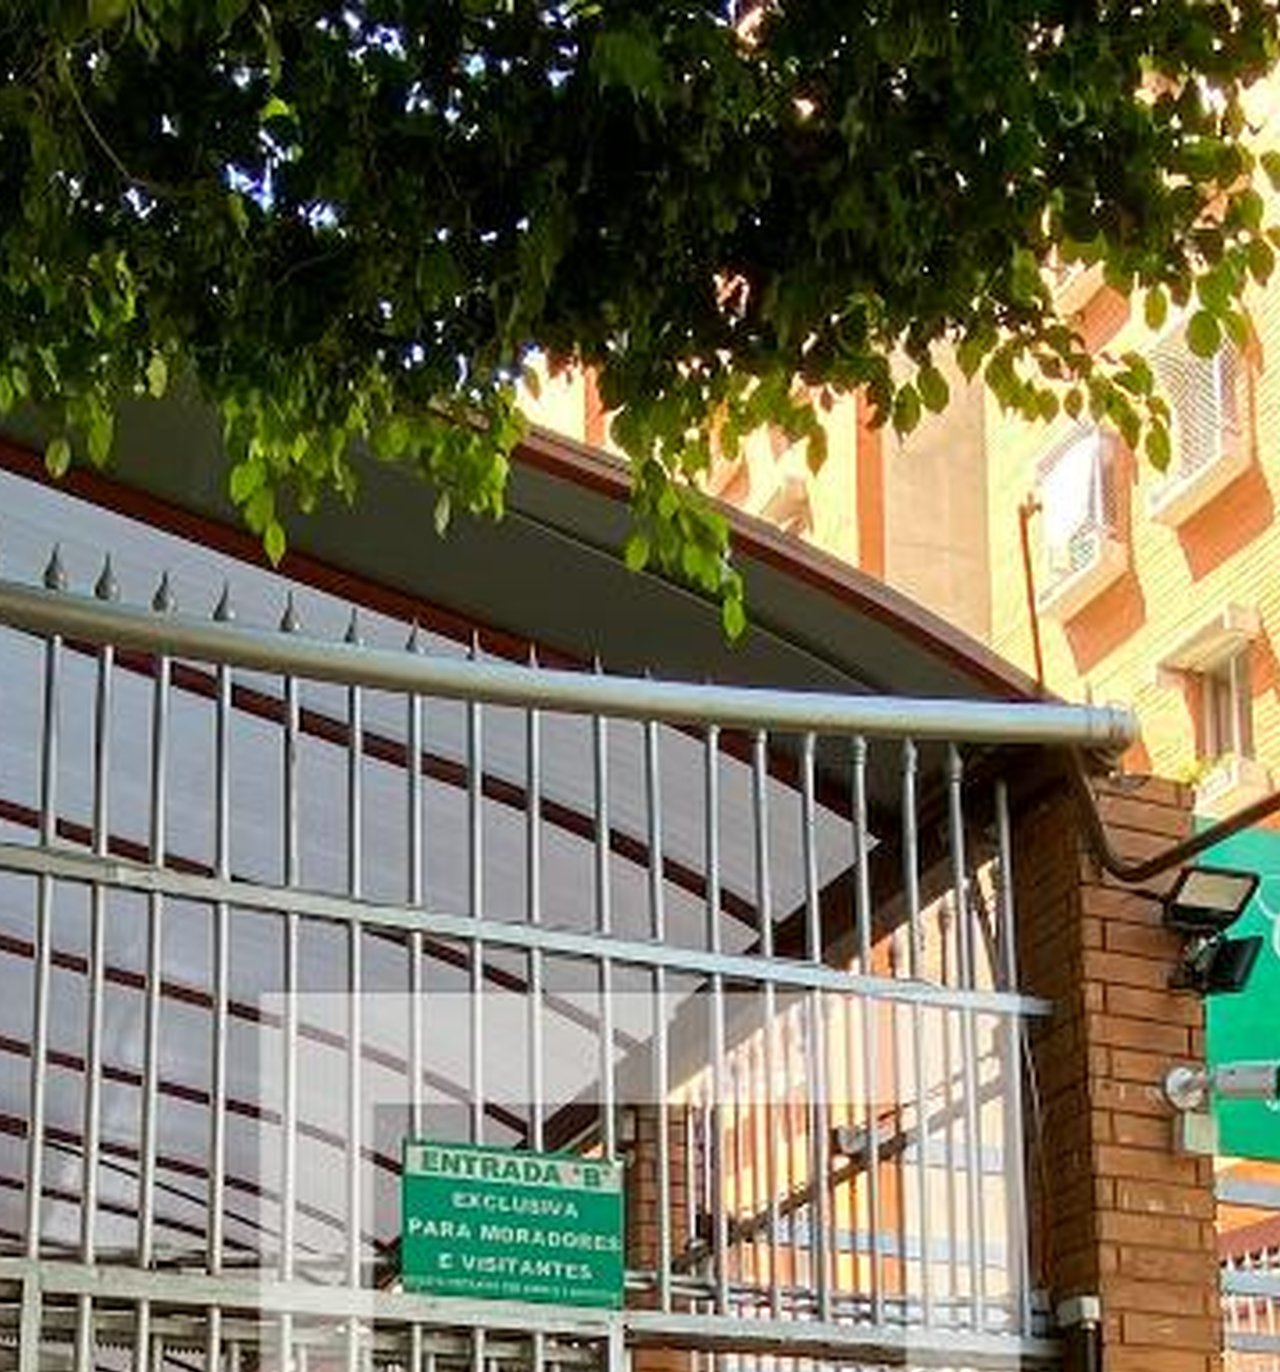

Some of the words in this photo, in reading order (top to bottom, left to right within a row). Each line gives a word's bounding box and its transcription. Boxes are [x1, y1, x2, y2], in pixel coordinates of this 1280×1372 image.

[422, 1150, 561, 1184] ENTRADA
[451, 1191, 579, 1219] EXCLUSIVA
[407, 1217, 471, 1240] PARA
[480, 1224, 621, 1251] MORADORES
[437, 1253, 454, 1270] E
[461, 1255, 593, 1281] VISITANTES
